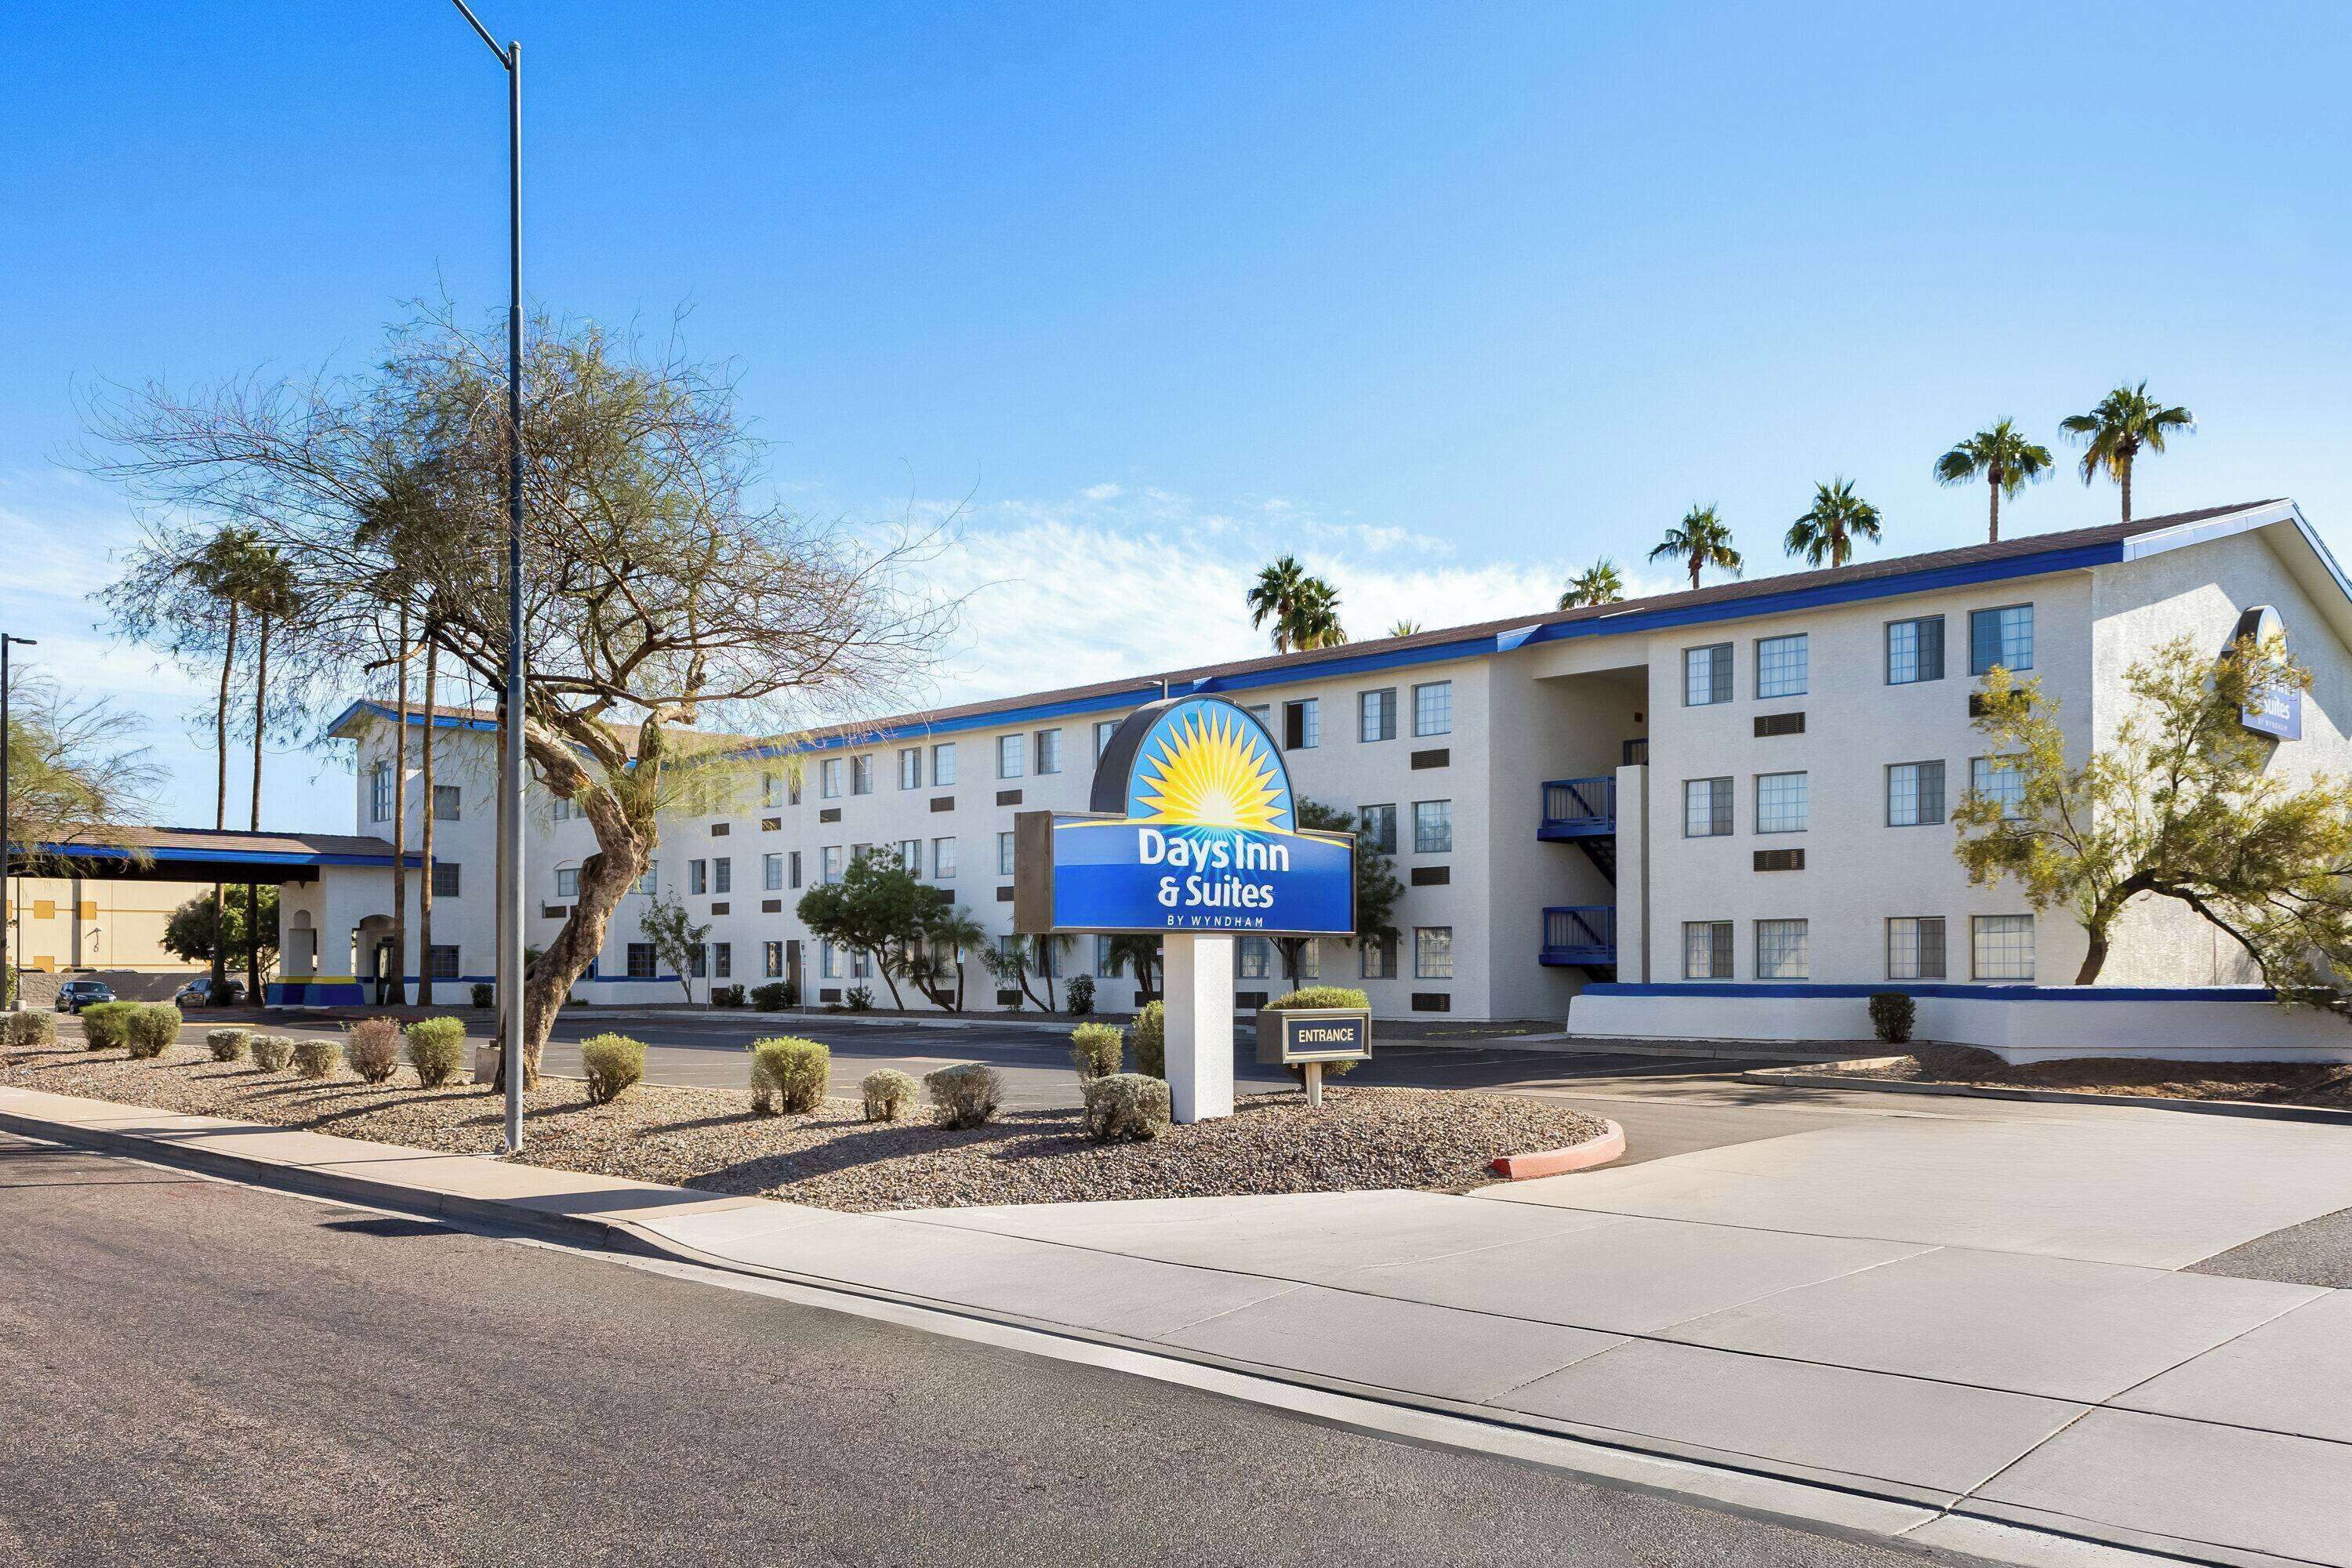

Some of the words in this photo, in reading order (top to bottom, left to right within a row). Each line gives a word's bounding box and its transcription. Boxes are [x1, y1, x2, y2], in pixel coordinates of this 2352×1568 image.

[1139, 828, 1229, 873] Days
[1236, 834, 1290, 872] Inn
[1157, 876, 1180, 907] &
[1185, 874, 1274, 909] Suites
[1167, 915, 1185, 926] BY
[1191, 916, 1263, 927] WYNDHAM
[1298, 1028, 1354, 1043] ENTRANCE
